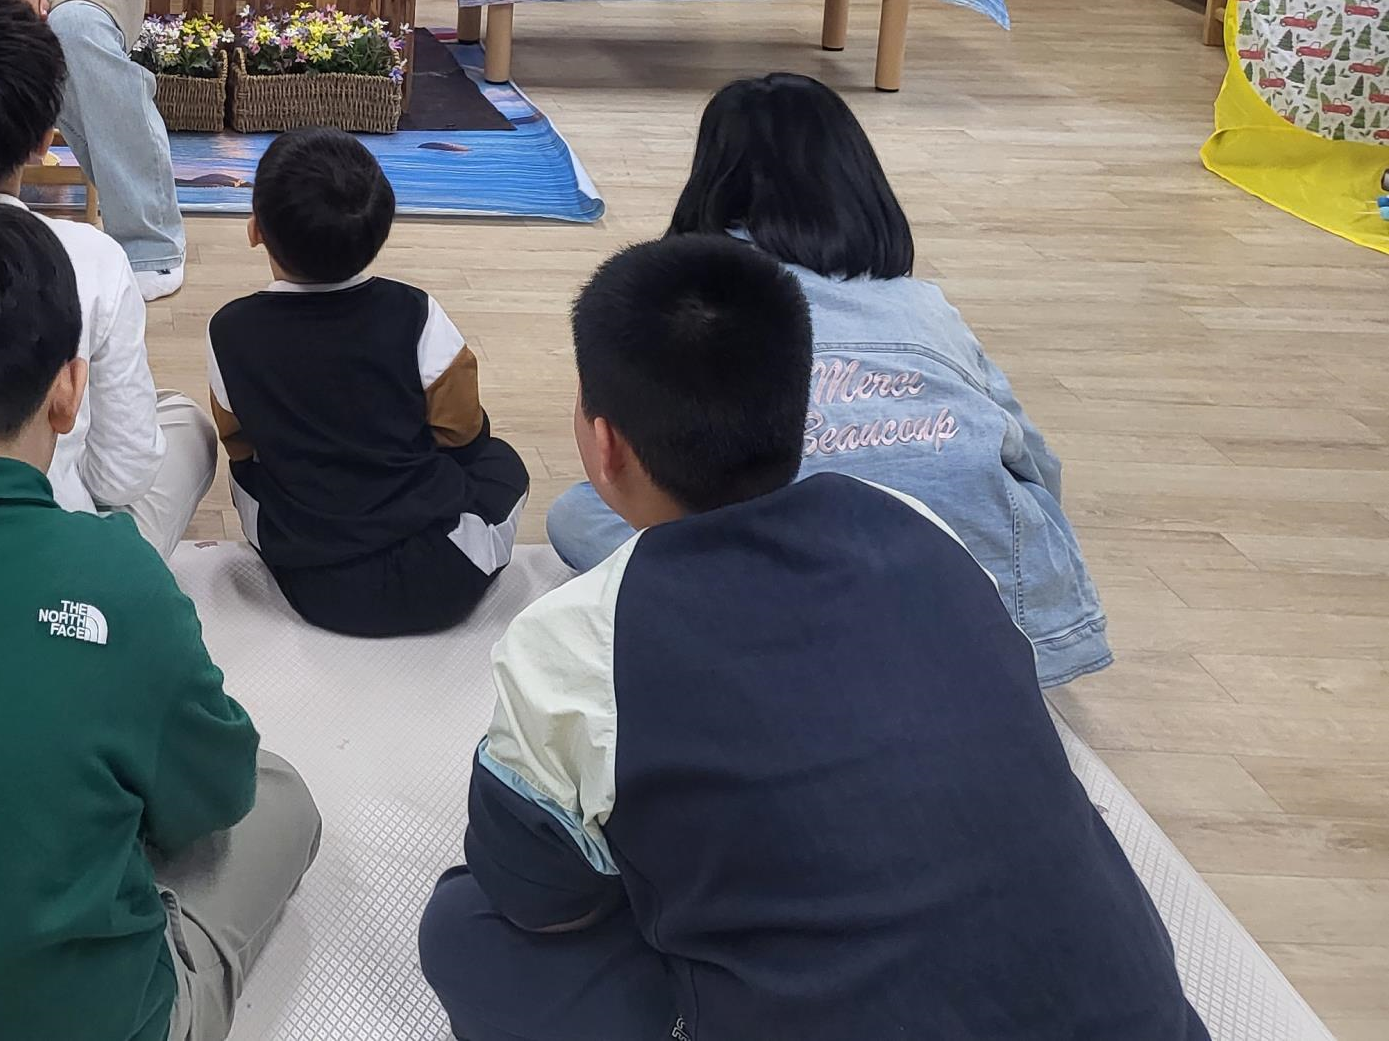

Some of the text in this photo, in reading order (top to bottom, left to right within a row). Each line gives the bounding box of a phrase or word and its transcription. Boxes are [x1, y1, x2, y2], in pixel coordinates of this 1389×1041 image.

[812, 359, 925, 406] Merci
[802, 408, 960, 454] Beaucoup
[60, 599, 88, 616] THE
[38, 608, 86, 628] NORTH
[50, 622, 86, 639] FACE
